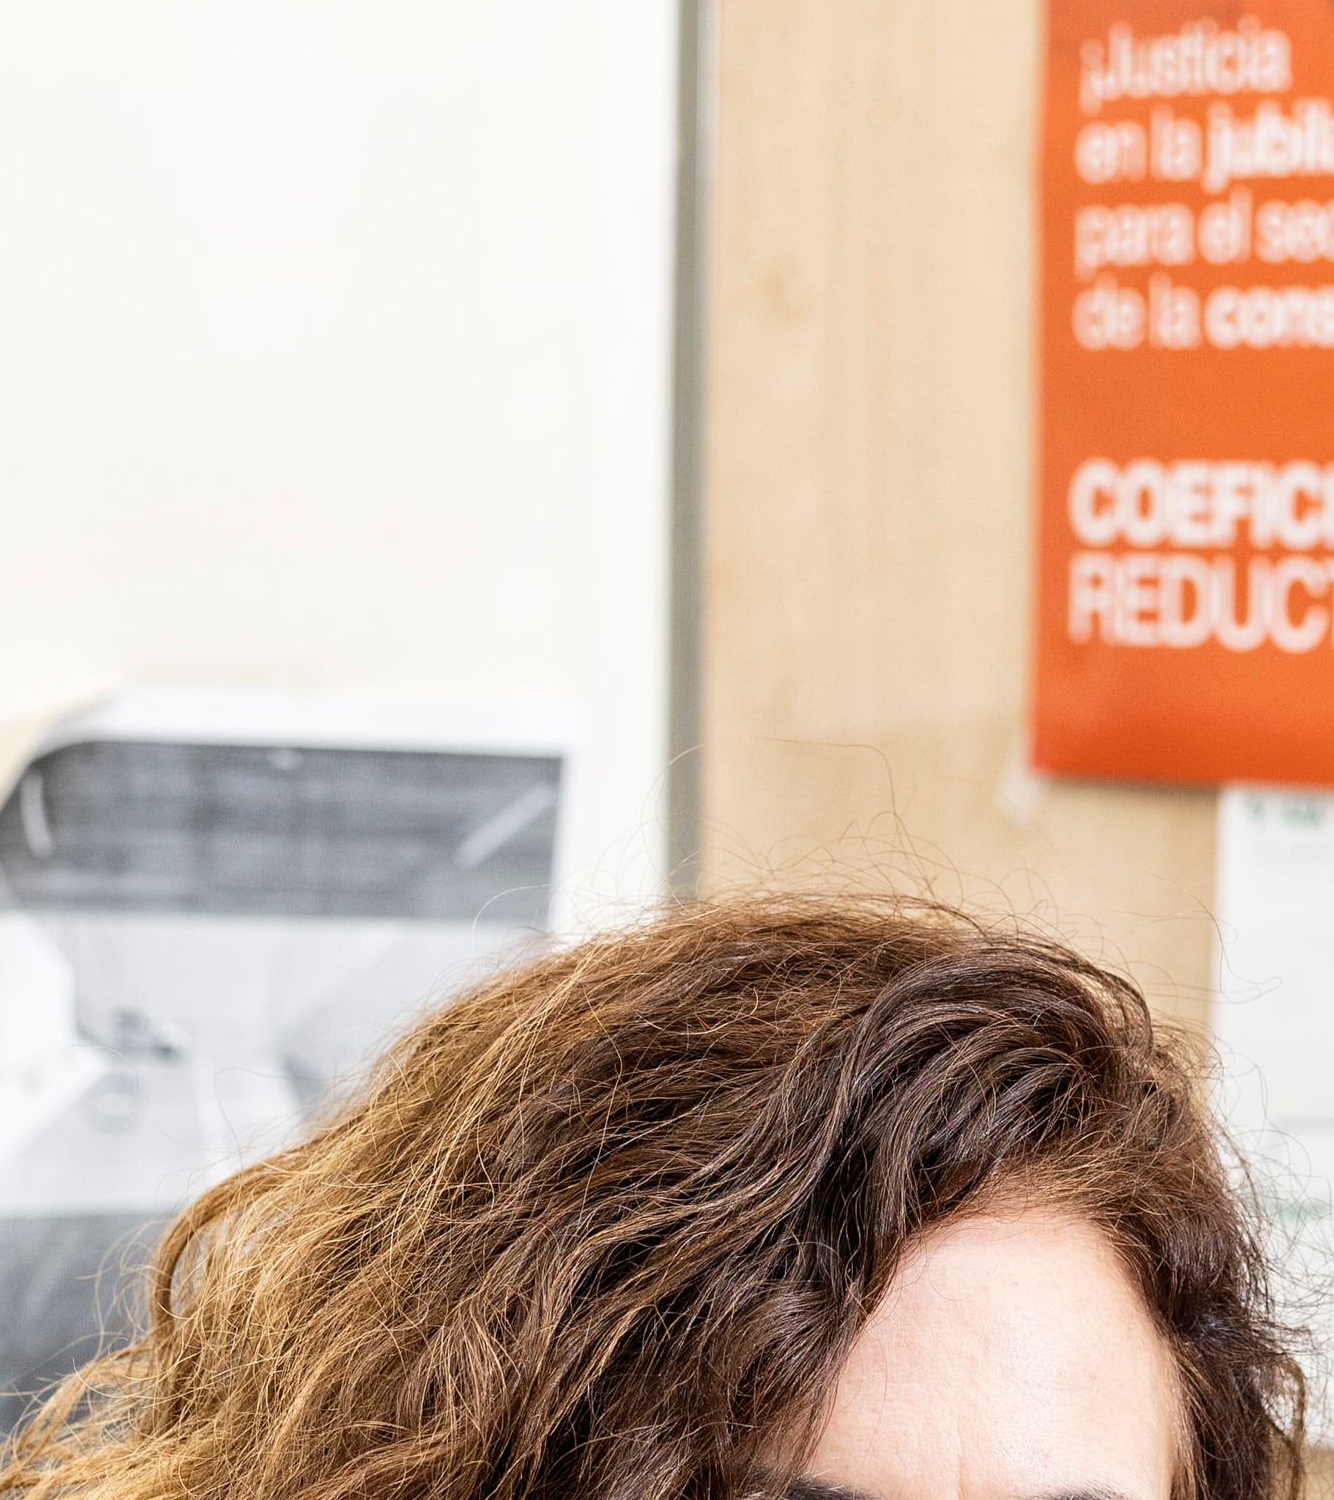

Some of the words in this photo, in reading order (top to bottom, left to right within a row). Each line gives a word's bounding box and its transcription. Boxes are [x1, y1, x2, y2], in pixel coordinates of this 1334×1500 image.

[1079, 18, 1293, 114] ¡Justicia
[1074, 120, 1146, 183] en
[1150, 103, 1202, 181] la
[1073, 202, 1194, 280] para
[1198, 186, 1253, 264] el
[1072, 274, 1146, 350] de
[1148, 272, 1200, 349] la
